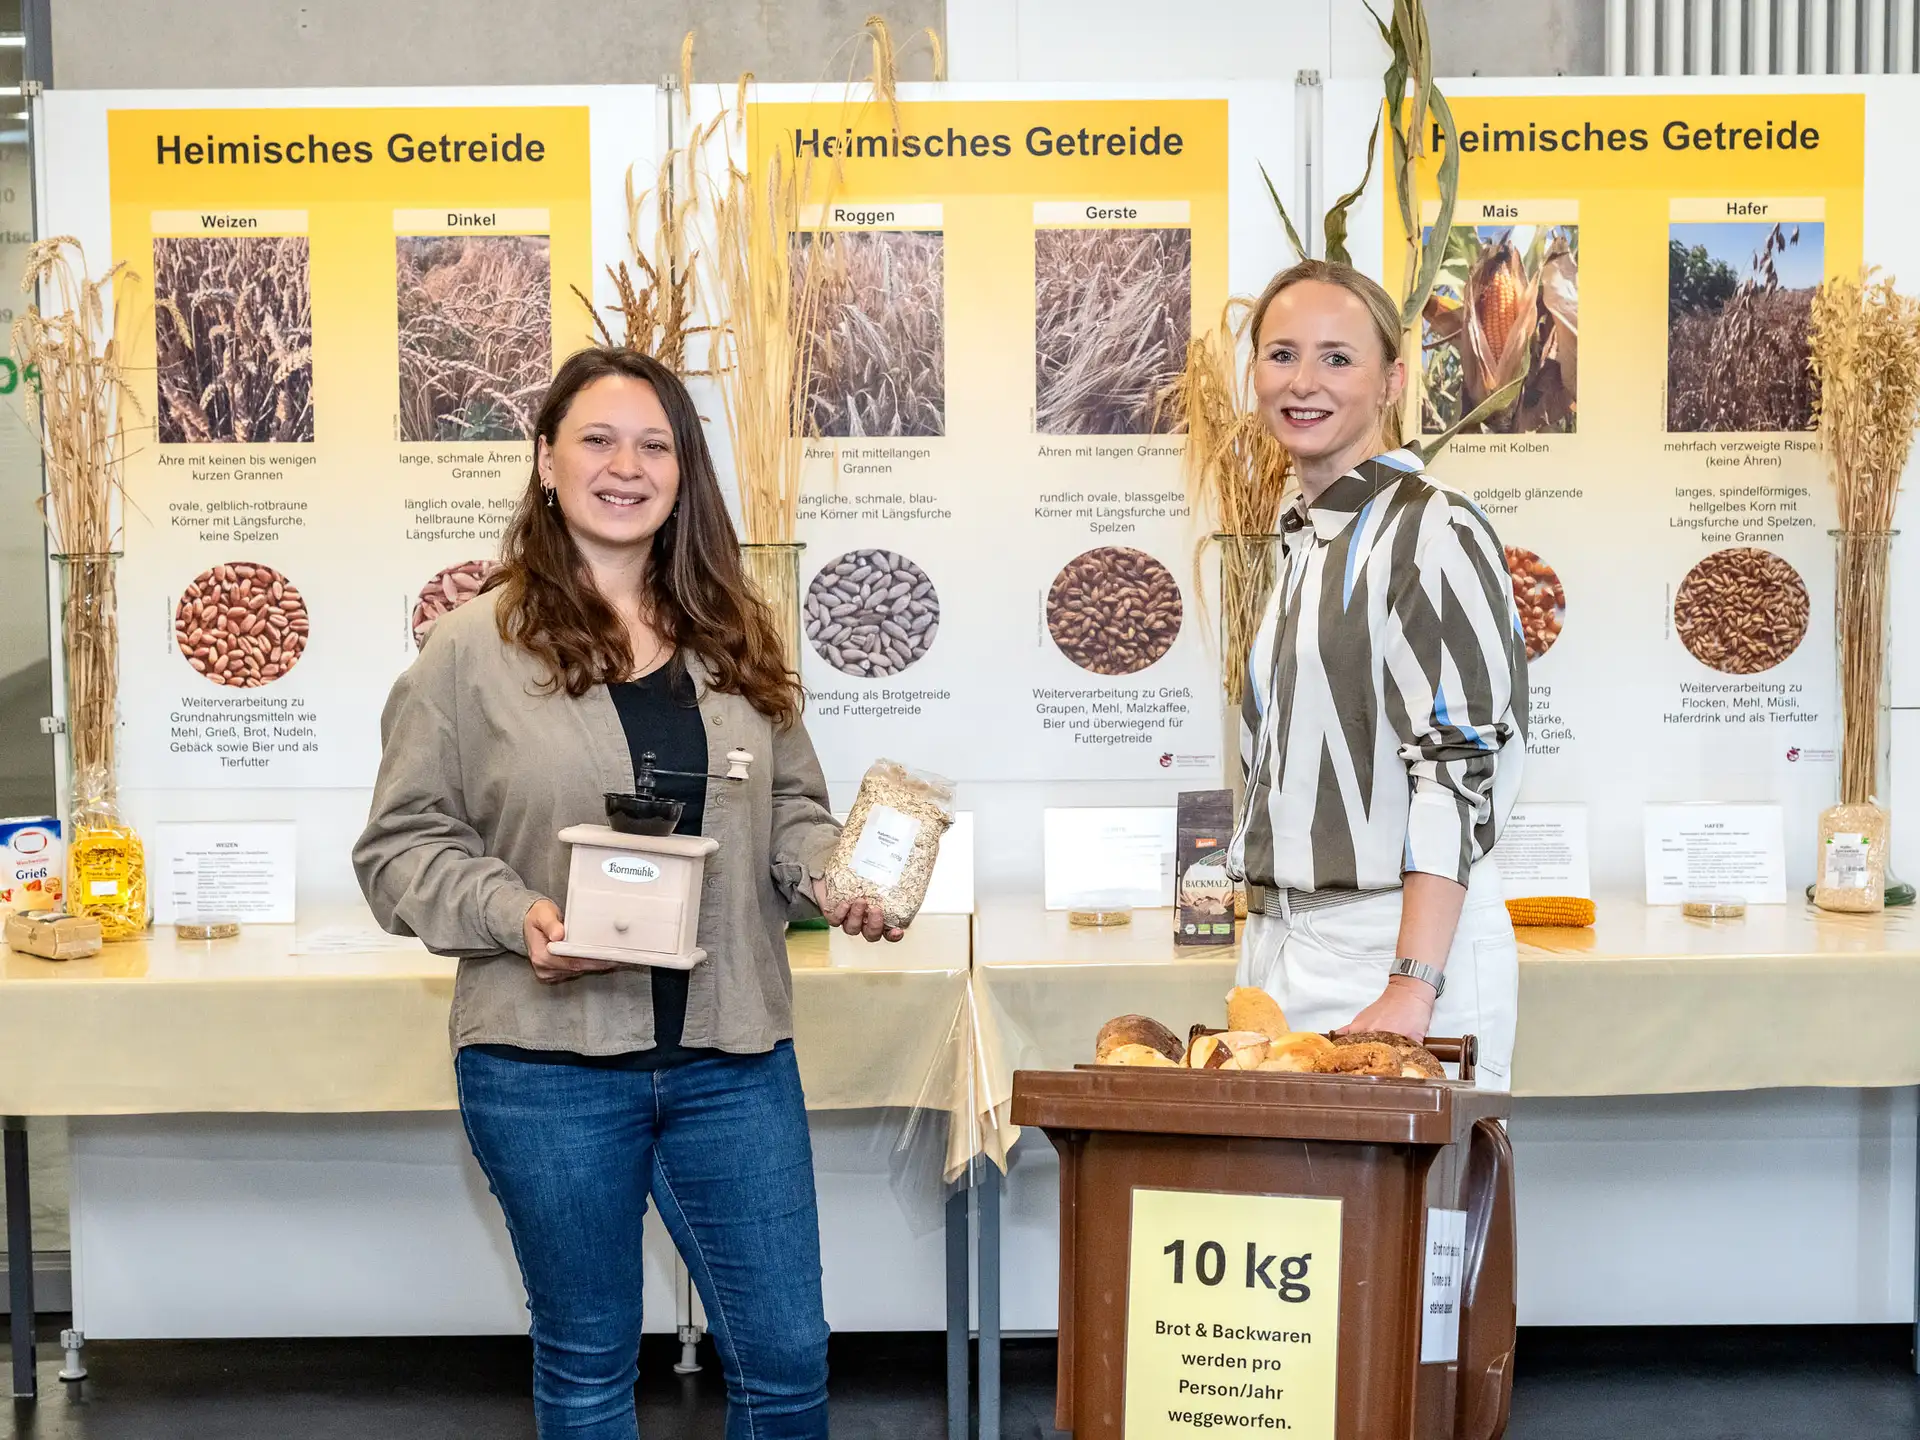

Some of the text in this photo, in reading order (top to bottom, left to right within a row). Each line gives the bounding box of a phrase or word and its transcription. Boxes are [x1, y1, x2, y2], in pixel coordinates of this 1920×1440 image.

[796, 126, 1183, 157] Heimisches Getreide
[1663, 121, 1819, 150] Getreide
[157, 133, 545, 164] Heimisches Getreide
[1085, 205, 1138, 220] Gerste
[1482, 204, 1519, 218] Mais
[1726, 201, 1769, 216] Hafer
[200, 214, 258, 229] Weizen
[447, 212, 496, 227] Dinkel
[834, 208, 895, 226] Roggen
[841, 448, 859, 459] mit
[861, 447, 931, 461] mittellangen
[1037, 445, 1072, 457] Ähren
[1075, 446, 1093, 457] mit
[1095, 446, 1134, 460] langen
[1449, 442, 1550, 454] Halme mit Kolben
[1663, 439, 1718, 453] mehrfach
[1719, 439, 1782, 454] verzweigte
[157, 453, 317, 468] Ähre mit keinen bis wenigen
[399, 453, 434, 467] lange,
[436, 452, 485, 464] schmale
[487, 450, 522, 464] Ähren
[1705, 454, 1782, 469] (keine Ähren)
[191, 469, 284, 481] kurzen Grannen
[451, 467, 501, 479] Grannen
[842, 462, 893, 475] Grannen
[797, 492, 938, 507] längliche, schmale, blau-
[1039, 491, 1185, 505] rundlich ovale, blassgelbe
[1472, 487, 1584, 502] goldgelb glänzende
[1675, 485, 1811, 500] langes, spindelförmiges,
[168, 500, 308, 514] ovale, gelblich-rotbraune
[404, 498, 448, 512] länglich
[450, 498, 485, 510] ovale,
[1034, 505, 1191, 520] Körner mit Längsfurche und
[1479, 503, 1519, 516] Körner
[1689, 500, 1797, 515] hellgelbes Korn mit
[171, 514, 306, 529] Körner mit Längsfurche,
[415, 513, 475, 525] hellbraune
[795, 507, 952, 522] üne Körner mit Längsfurche
[1089, 521, 1136, 535] Spelzen
[1669, 515, 1816, 530] Längsfurche und Spelzen,
[199, 529, 279, 544] keine Spelzen
[405, 528, 500, 542] Längsfurche und
[1701, 531, 1785, 543] keine Grannen
[1031, 686, 1194, 701] Weiterverarbeitung zu Grieß,
[1679, 681, 1803, 695] Weiterverarbeitung zu
[181, 696, 305, 710] Weiterverarbeitung zu
[804, 689, 951, 703] rwendung als Brotgetreide
[1681, 696, 1800, 709] Flocken, Mehl, Müsli,
[818, 703, 922, 718] und Futtergetreide
[1035, 702, 1190, 716] Graupen, Mehl, Malzkaffee,
[1536, 700, 1550, 710] zu
[169, 711, 317, 725] Grundnahrungsmitteln wie
[1043, 717, 1184, 732] Bier und überwiegend für
[1663, 711, 1819, 724] Haferdrink und als Tierfutter
[170, 726, 317, 739] Mehl, Grieß, Brot, Nudeln,
[1074, 732, 1153, 746] Futtergetreide
[1540, 728, 1576, 741] Grieß,
[169, 741, 319, 753] Gebäck sowie Bier und als
[1524, 742, 1561, 755] rfutter
[219, 755, 270, 768] Tierfutter
[15, 866, 48, 882] Grieß
[608, 861, 655, 878] Kornmühle
[1185, 879, 1230, 889] BACKMALZ
[1164, 1240, 1312, 1303] 10 kg
[1155, 1319, 1312, 1344] Brot & Backwaren
[1181, 1352, 1282, 1373] werden pro
[1179, 1379, 1284, 1400] Person/Jahr
[1167, 1410, 1292, 1430] weggeworfen.
